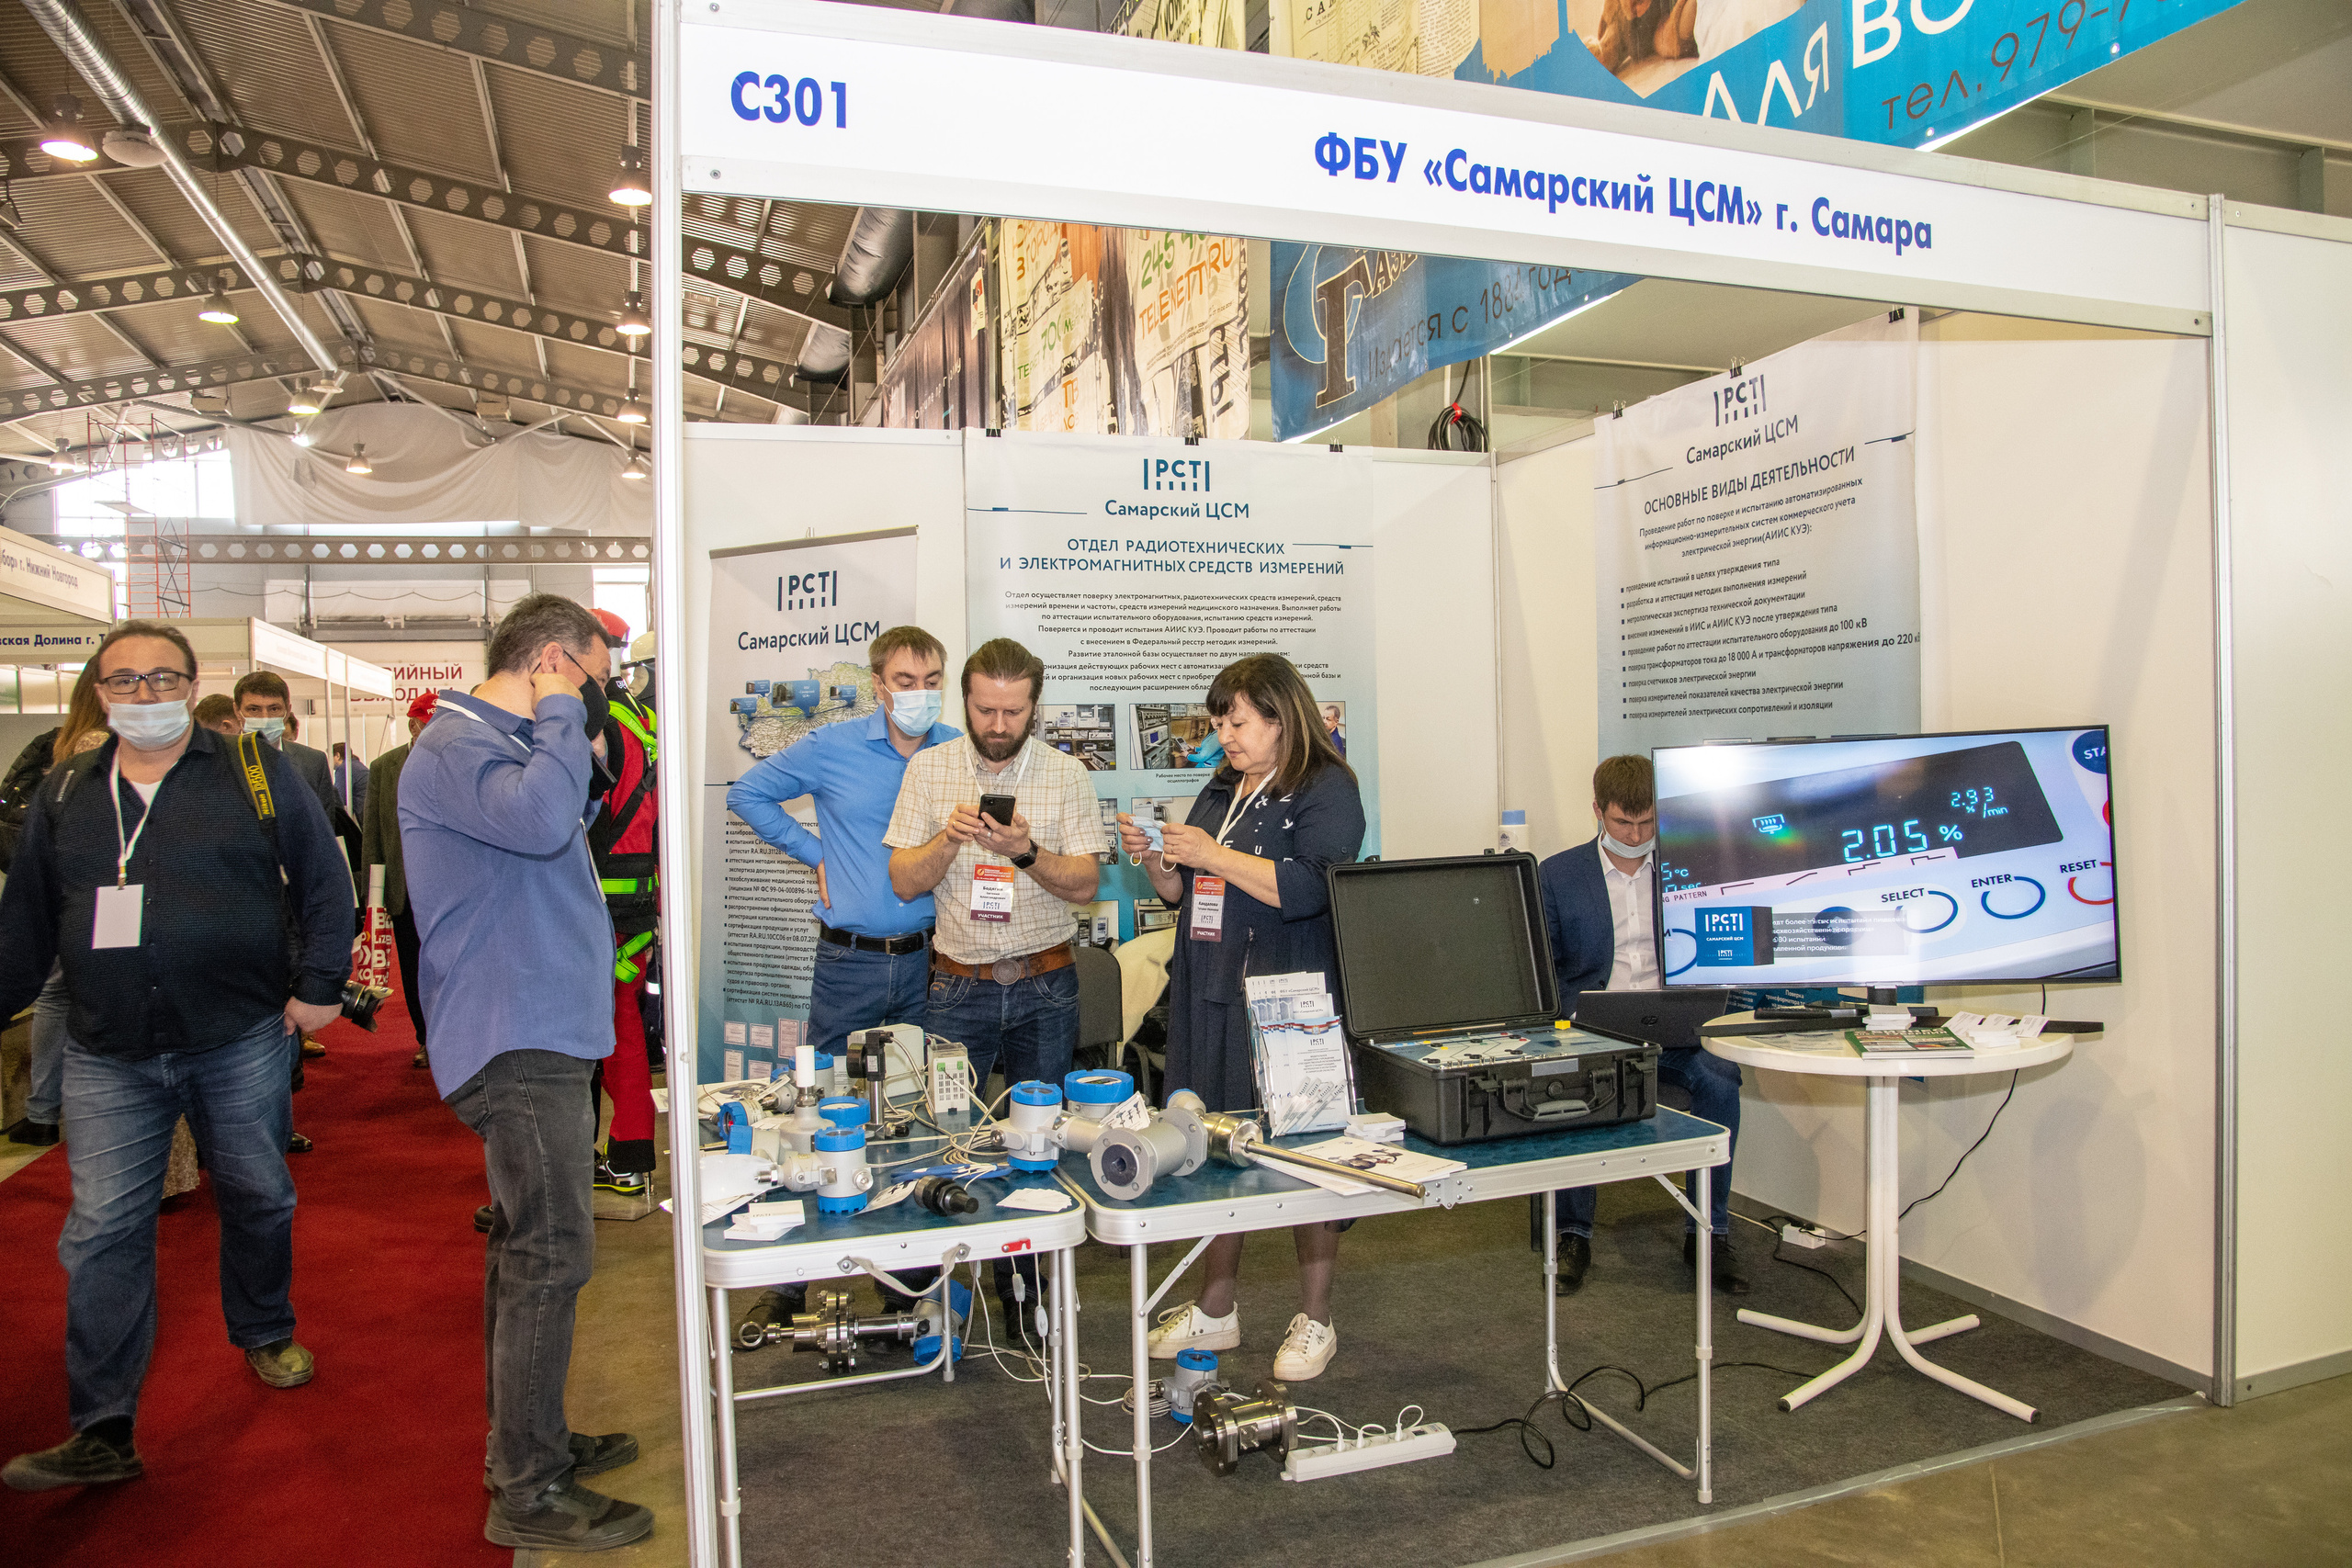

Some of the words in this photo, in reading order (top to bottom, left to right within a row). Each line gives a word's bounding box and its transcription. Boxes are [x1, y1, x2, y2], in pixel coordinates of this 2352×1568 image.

[1883, 69, 1983, 130] тел.
[1314, 131, 1407, 184] ФБУ
[1423, 148, 1654, 213] «Самарский
[1668, 177, 1762, 226] ЦСМ»
[1776, 204, 1797, 231] г.
[1811, 196, 1933, 254] Самара
[1687, 429, 1761, 465] Самарский
[1765, 414, 1800, 445] ЦСМ
[1645, 487, 1708, 515] ОСНОВНЫЕ
[1712, 476, 1747, 499] ВИДЫ
[1750, 446, 1855, 492] ДЕЯТЕЛЬНОСТИ
[1104, 500, 1200, 520] Самарский
[1205, 502, 1250, 520] ЦСМ
[1639, 523, 1676, 537] Проведение
[1677, 518, 1695, 530] работ
[1707, 510, 1735, 521] поверке
[1742, 499, 1784, 513] испытанию
[1751, 516, 1778, 527] систем
[1835, 497, 1855, 511] учета
[1791, 524, 1812, 536] КУЭ):
[1068, 538, 1119, 553] ОТДЕЛ
[1126, 540, 1285, 555] РАДИОТЕХНИЧЕСКИХ
[1000, 558, 1012, 569] И
[1019, 558, 1186, 573] ЭЛЕКТРОМАГНИТНЫХ
[1189, 560, 1253, 574] СРЕДСТВ
[1260, 560, 1344, 575] ИЗМЕРЕНИЙ
[1005, 591, 1029, 599] Отдел
[1277, 594, 1317, 603] измерений,
[1006, 602, 1046, 611] измерений
[1148, 604, 1187, 612] измерений
[1282, 604, 1317, 612] Выполняет
[1319, 604, 1341, 613] работы
[1152, 614, 1203, 623] оборудования,
[1274, 615, 1313, 623] измерений.
[738, 626, 829, 653] Самарский
[834, 620, 880, 646] ЦСМ
[1038, 625, 1080, 634] Поверяется
[1206, 626, 1242, 635] Проводит
[1243, 626, 1268, 635] работы
[1628, 646, 1656, 655] проведение
[1657, 642, 1676, 653] работ
[1686, 639, 1721, 649] аттестации
[1828, 624, 1838, 633] до
[1841, 619, 1854, 629] 100
[1856, 617, 1867, 628] кВ
[34, 634, 82, 648] Долина
[86, 636, 95, 645] г.
[1238, 638, 1277, 647] измерений.
[259, 794, 270, 815] Nikon
[1951, 786, 1995, 808] 2.93
[1841, 819, 1928, 863] 2.05
[1939, 825, 1963, 841] %
[2059, 859, 2098, 874] RESET
[1971, 874, 2013, 888] ENTER
[1674, 890, 1707, 901] PATTERN
[1882, 888, 1926, 903] SELECT
